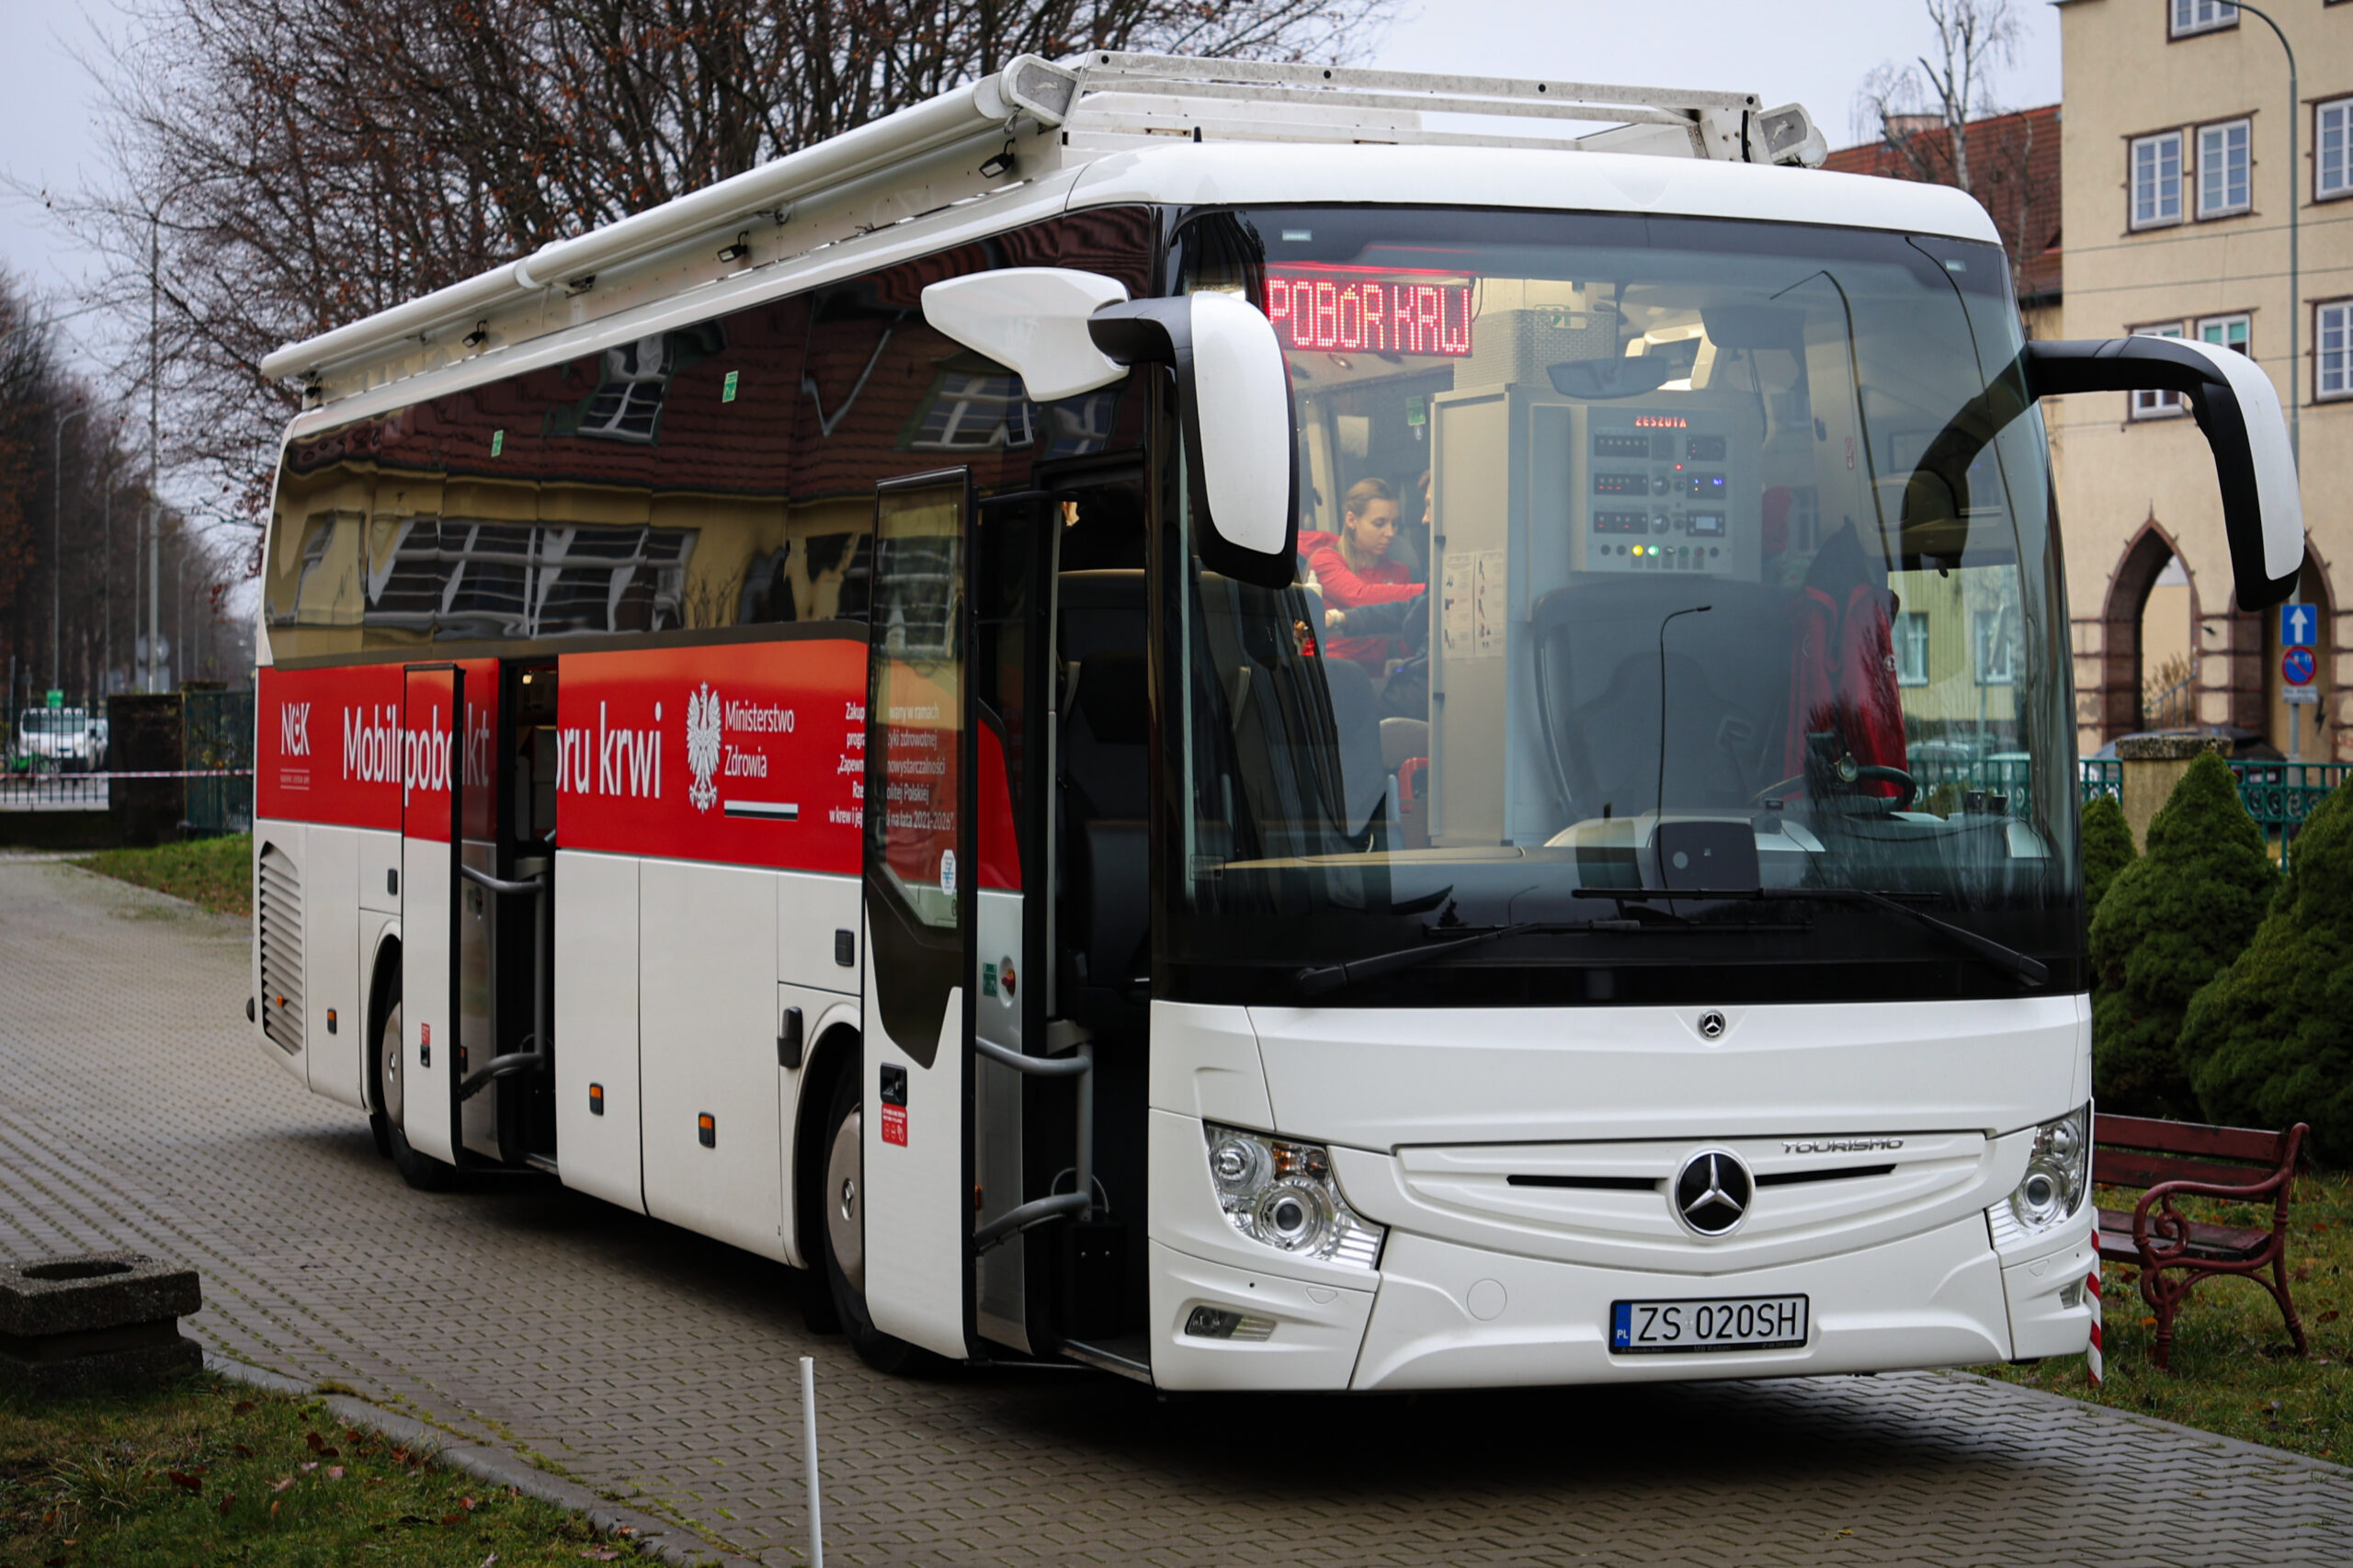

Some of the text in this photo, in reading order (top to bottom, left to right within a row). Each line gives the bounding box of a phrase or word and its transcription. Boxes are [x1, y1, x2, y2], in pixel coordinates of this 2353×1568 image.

[1268, 279, 1383, 349] POBÓR
[725, 699, 794, 733] Ministerstwo
[462, 702, 490, 788] kt
[599, 701, 662, 799] krwi
[901, 728, 938, 751] zdrowotnej
[724, 745, 767, 778] Zdrowia
[904, 783, 929, 805] Polskiej
[1782, 1138, 1904, 1153] TOURISMO
[1617, 1302, 1796, 1341] PL ZS 020SH
